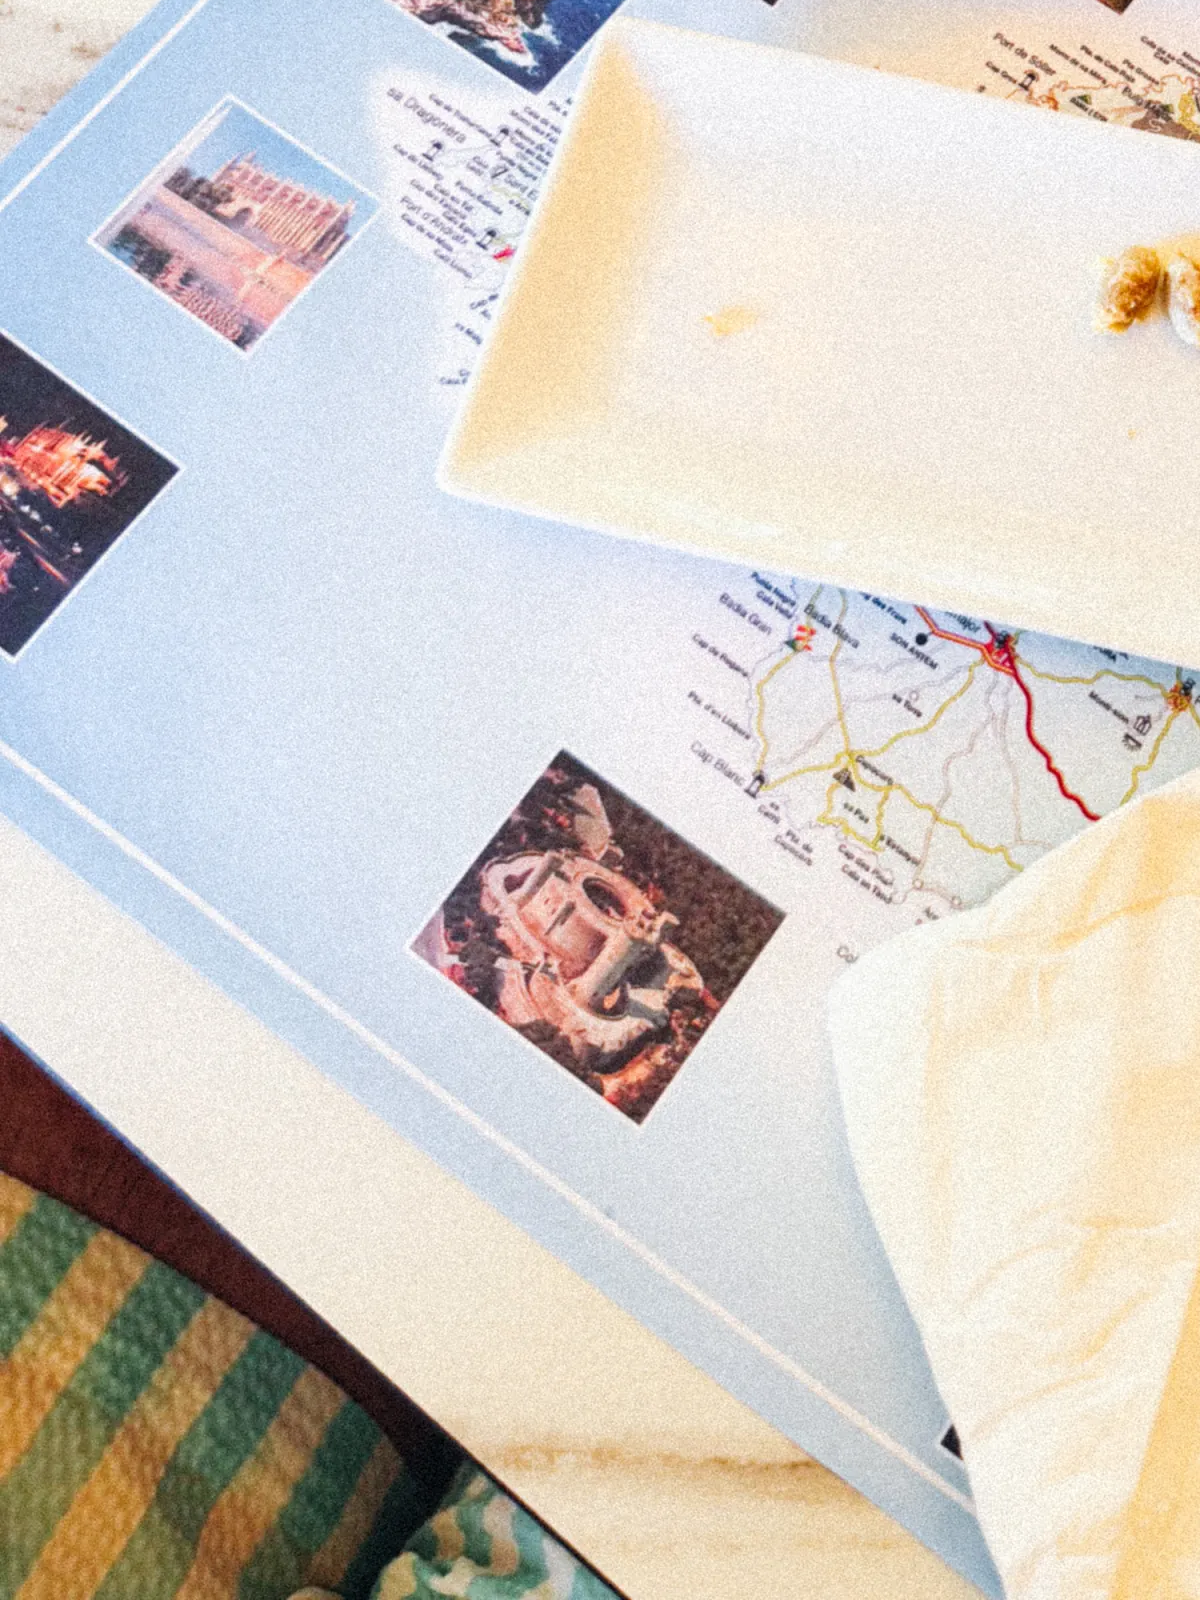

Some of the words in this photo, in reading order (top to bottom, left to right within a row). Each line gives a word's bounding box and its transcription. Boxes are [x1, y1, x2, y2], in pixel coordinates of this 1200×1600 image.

[992, 31, 1016, 51] Port
[386, 86, 405, 103] sa
[403, 95, 468, 145] Dragonera
[718, 590, 749, 619] Badia
[747, 611, 773, 638] Gran
[803, 603, 833, 630] Badia
[831, 622, 861, 650] Blava
[889, 631, 910, 650] SON
[689, 739, 715, 765] Cap
[713, 757, 746, 788] Blanc
